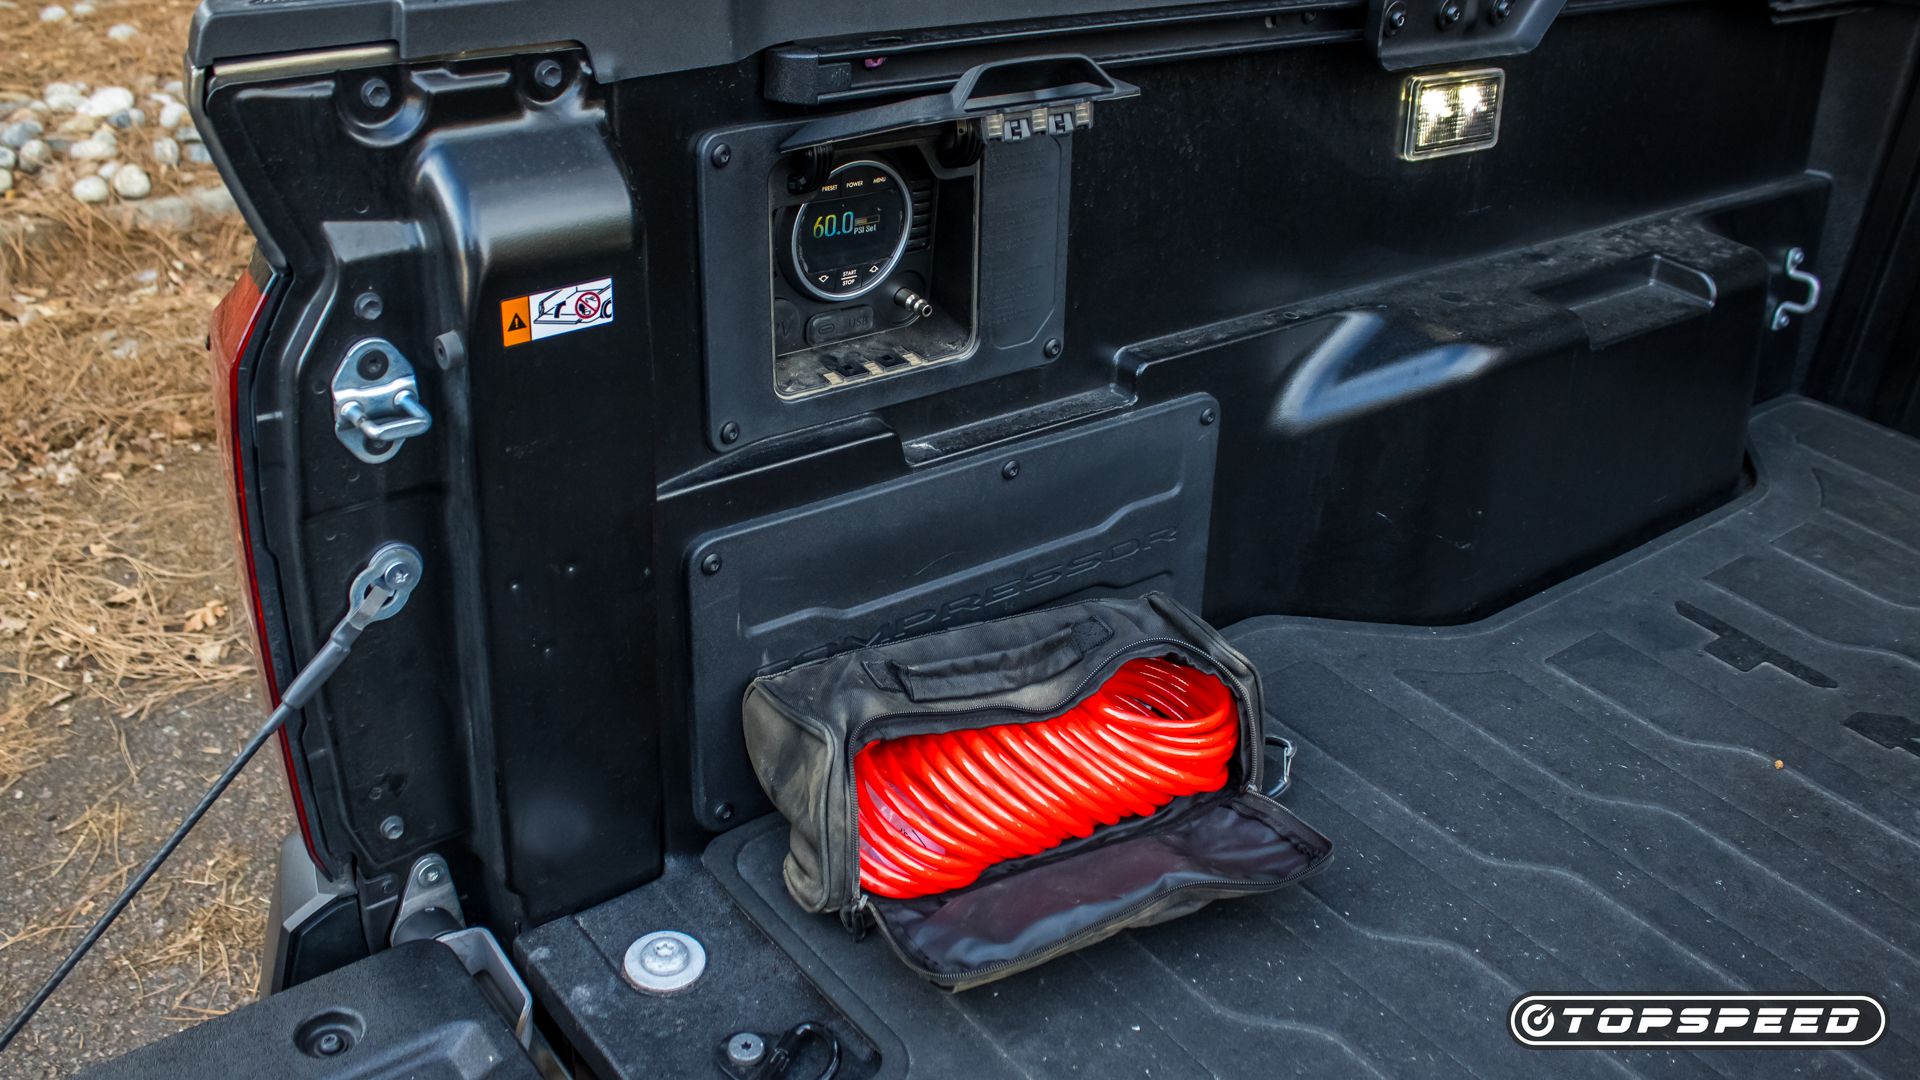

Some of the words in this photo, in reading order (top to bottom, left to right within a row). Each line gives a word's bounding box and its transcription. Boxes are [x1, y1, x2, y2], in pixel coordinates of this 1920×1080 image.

[846, 180, 864, 189] POWER
[873, 176, 888, 185] MENU
[821, 184, 838, 193] PRESET
[812, 210, 855, 240] 60.0
[853, 226, 865, 236] PSI
[865, 223, 878, 233] Set
[842, 269, 857, 277] START
[842, 278, 856, 287] STOP
